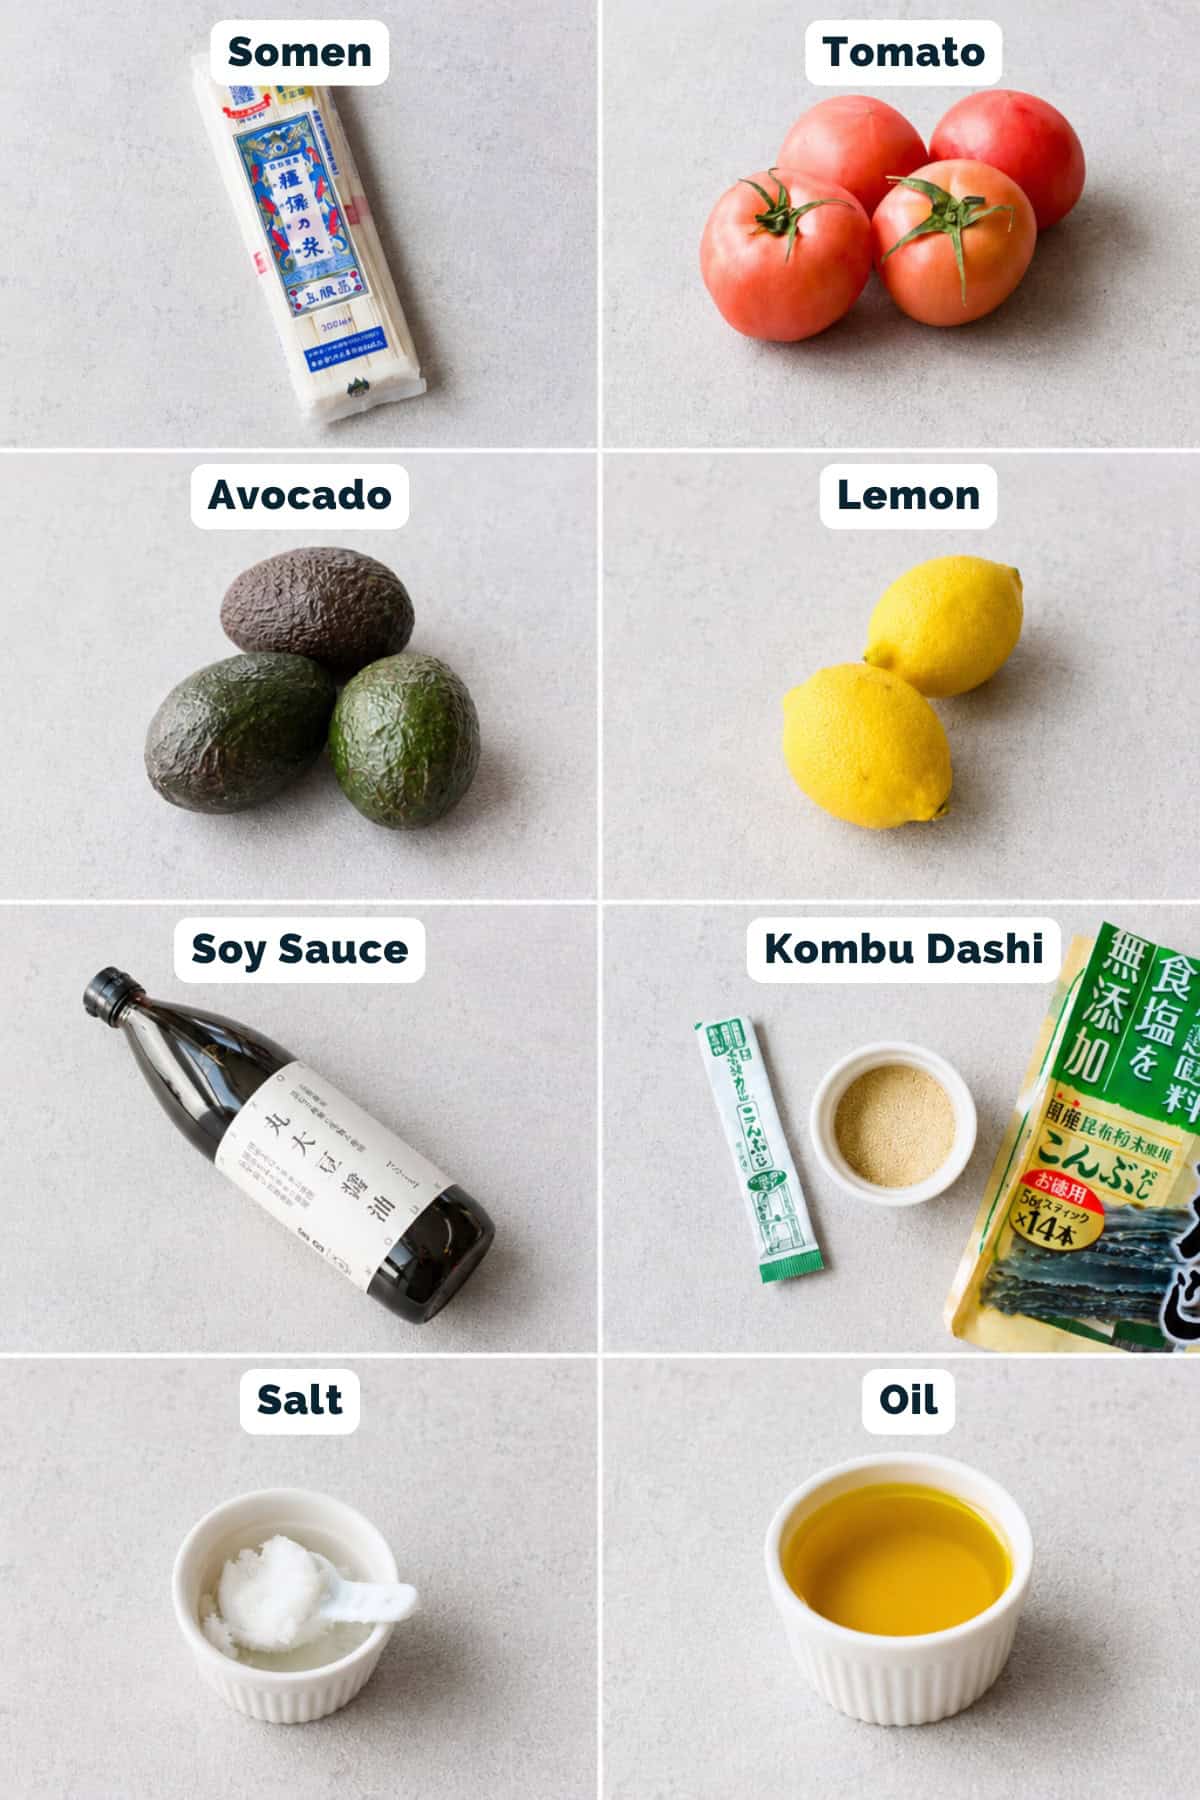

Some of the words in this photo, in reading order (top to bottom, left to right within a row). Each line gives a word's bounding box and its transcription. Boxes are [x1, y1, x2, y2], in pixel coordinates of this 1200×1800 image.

[1063, 929, 1149, 1084] 無添加
[1129, 954, 1198, 1082] 食塩を
[1034, 1171, 1087, 1204] お徳用
